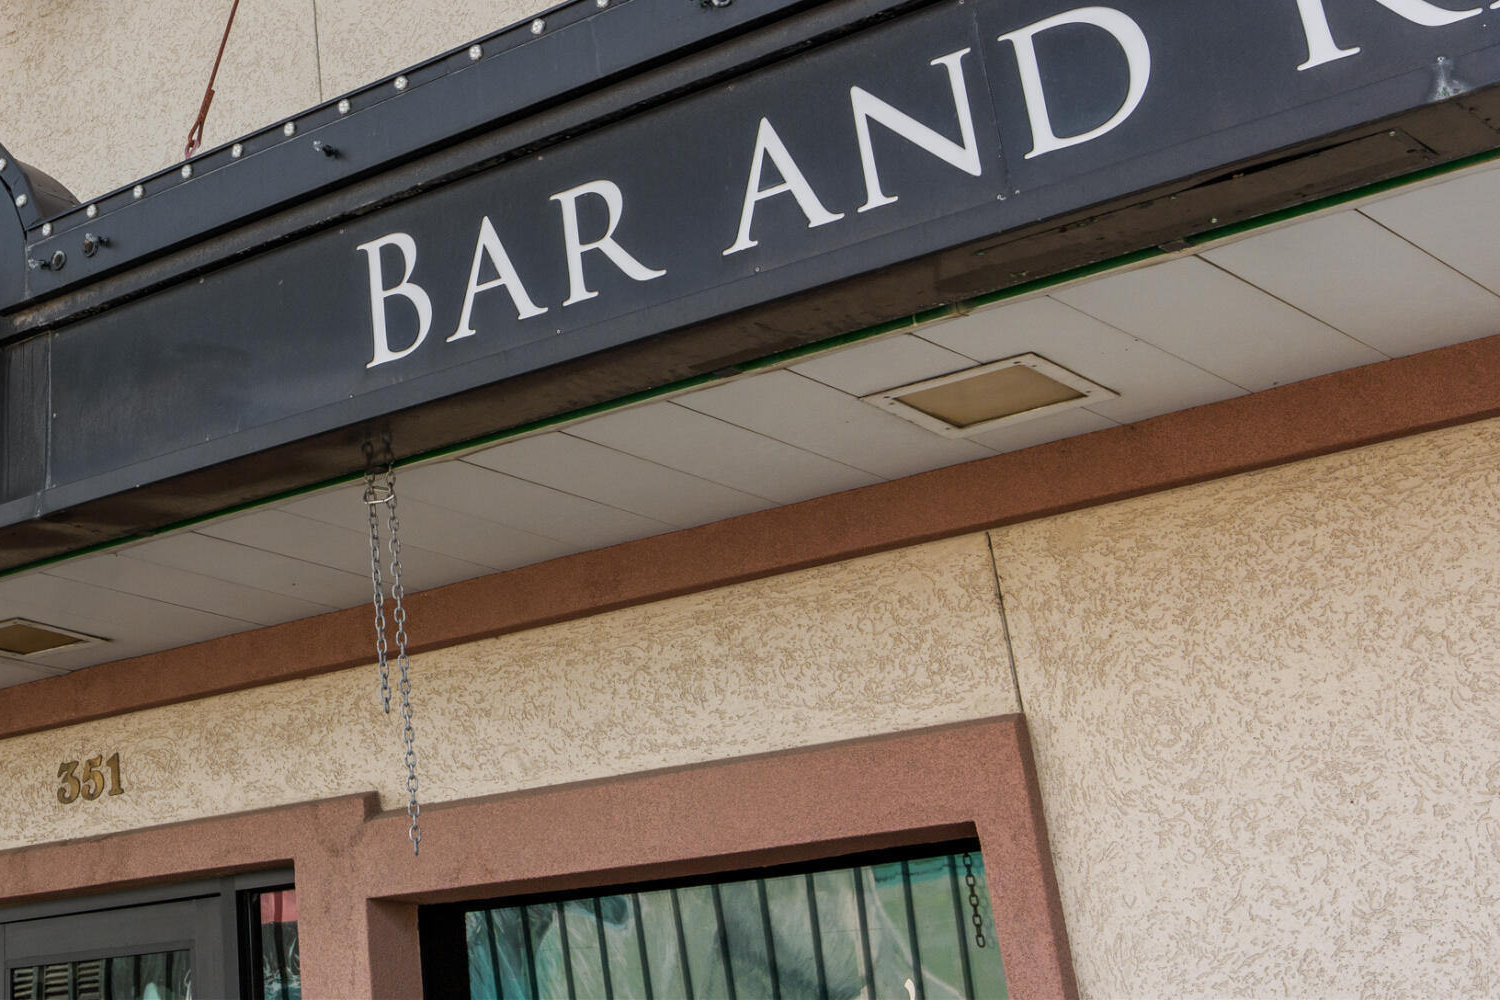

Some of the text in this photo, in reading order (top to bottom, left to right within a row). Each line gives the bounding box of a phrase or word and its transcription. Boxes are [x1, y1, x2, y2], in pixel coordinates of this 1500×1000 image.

[356, 179, 666, 369] BAR
[721, 6, 1152, 257] AND
[57, 752, 124, 804] 351
